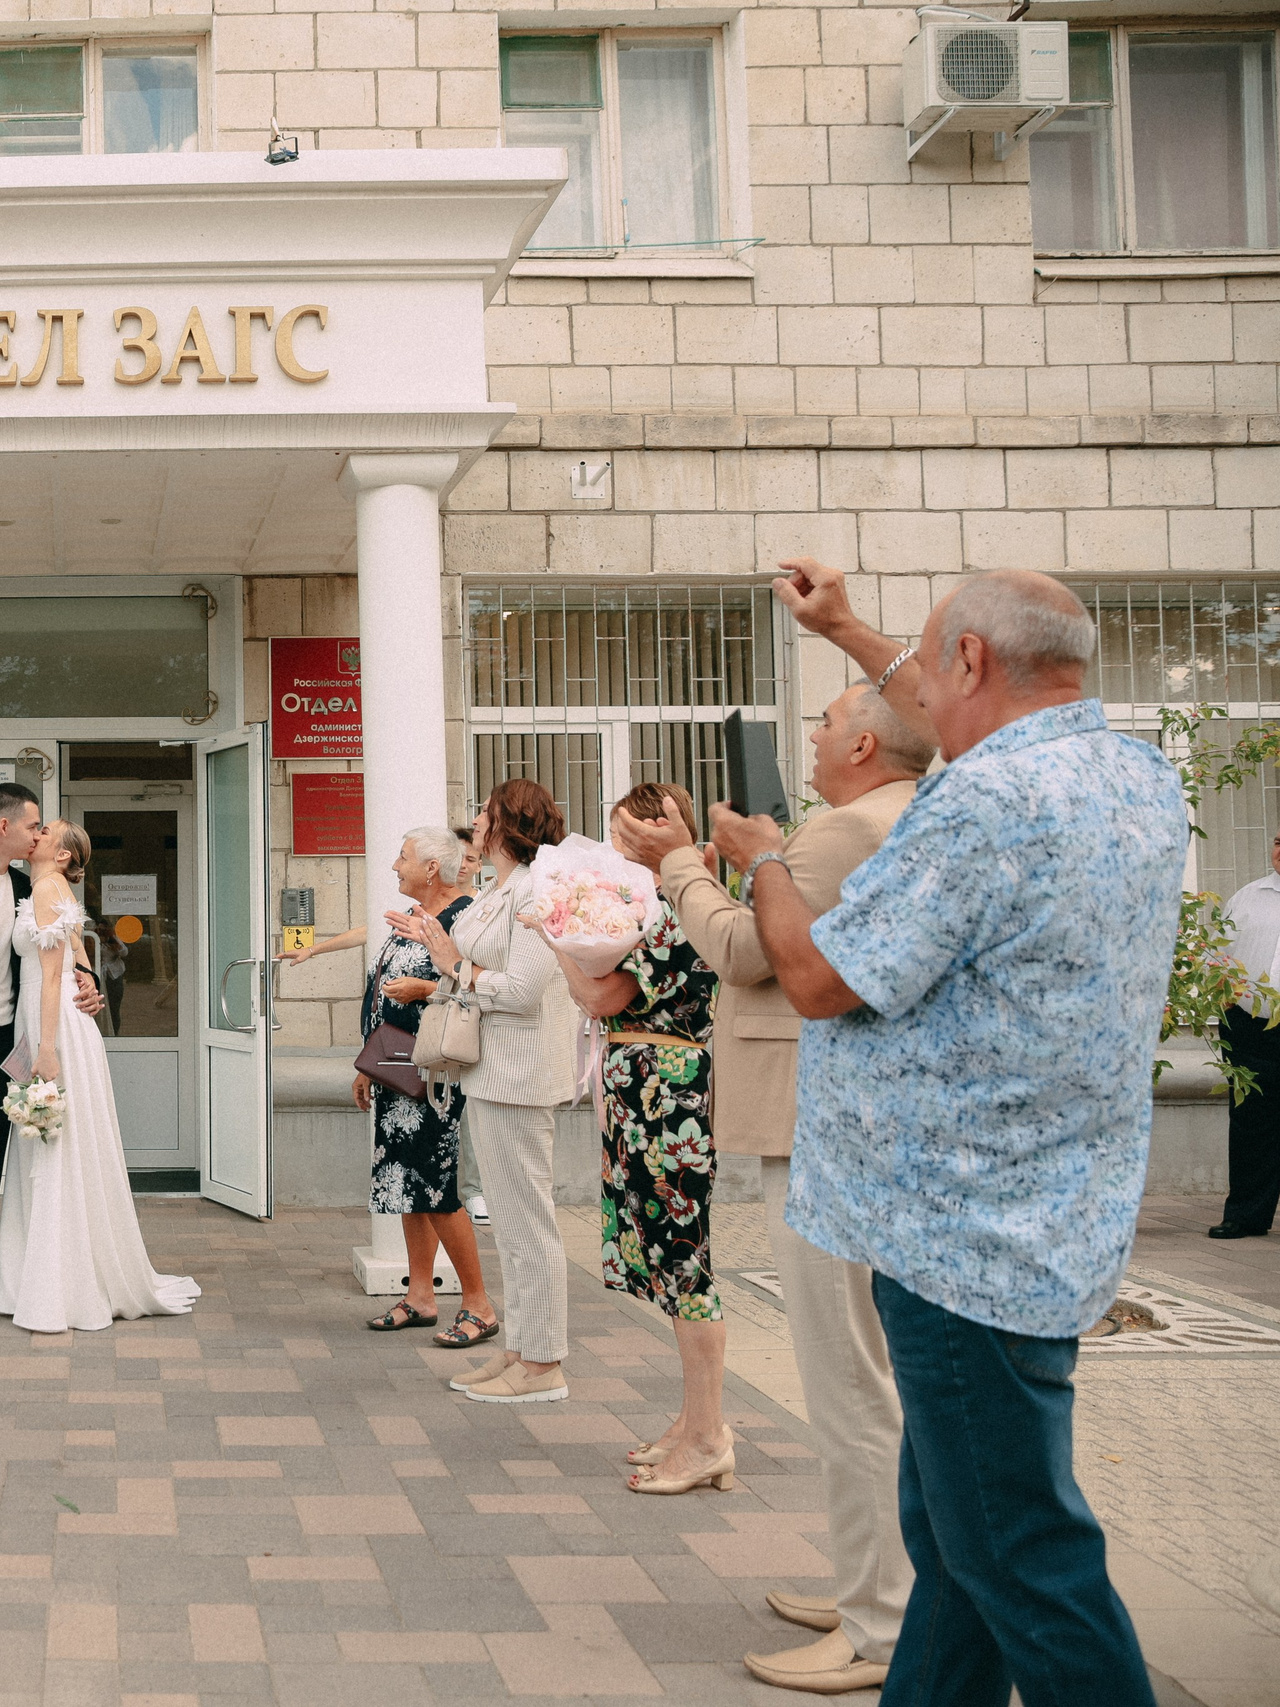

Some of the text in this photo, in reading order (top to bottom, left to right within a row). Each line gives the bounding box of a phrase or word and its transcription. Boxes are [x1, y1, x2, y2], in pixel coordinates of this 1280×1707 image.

[113, 304, 330, 385] ЗАГС
[294, 678, 353, 687] Российская
[281, 692, 358, 716] Отдел
[330, 776, 355, 784] Отдел
